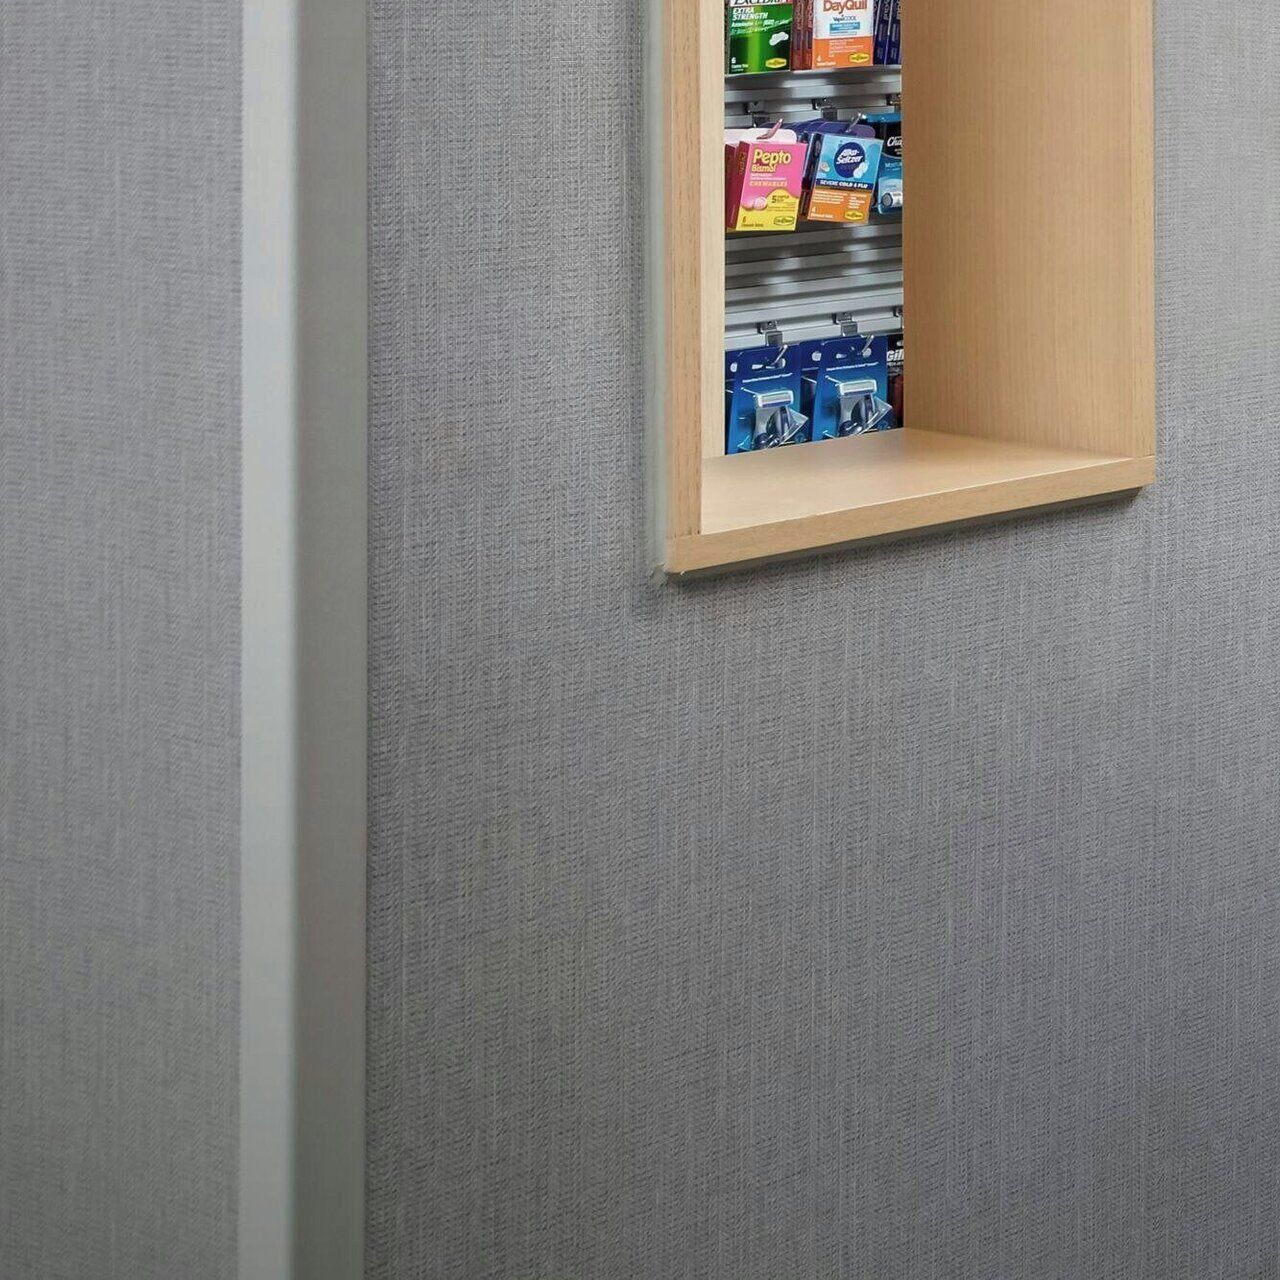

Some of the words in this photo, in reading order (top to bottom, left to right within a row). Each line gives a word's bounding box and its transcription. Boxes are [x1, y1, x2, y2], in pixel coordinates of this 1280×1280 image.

[732, 13, 769, 21] STRENGTH
[752, 148, 792, 166] Pepto
[751, 163, 777, 174] Bismol
